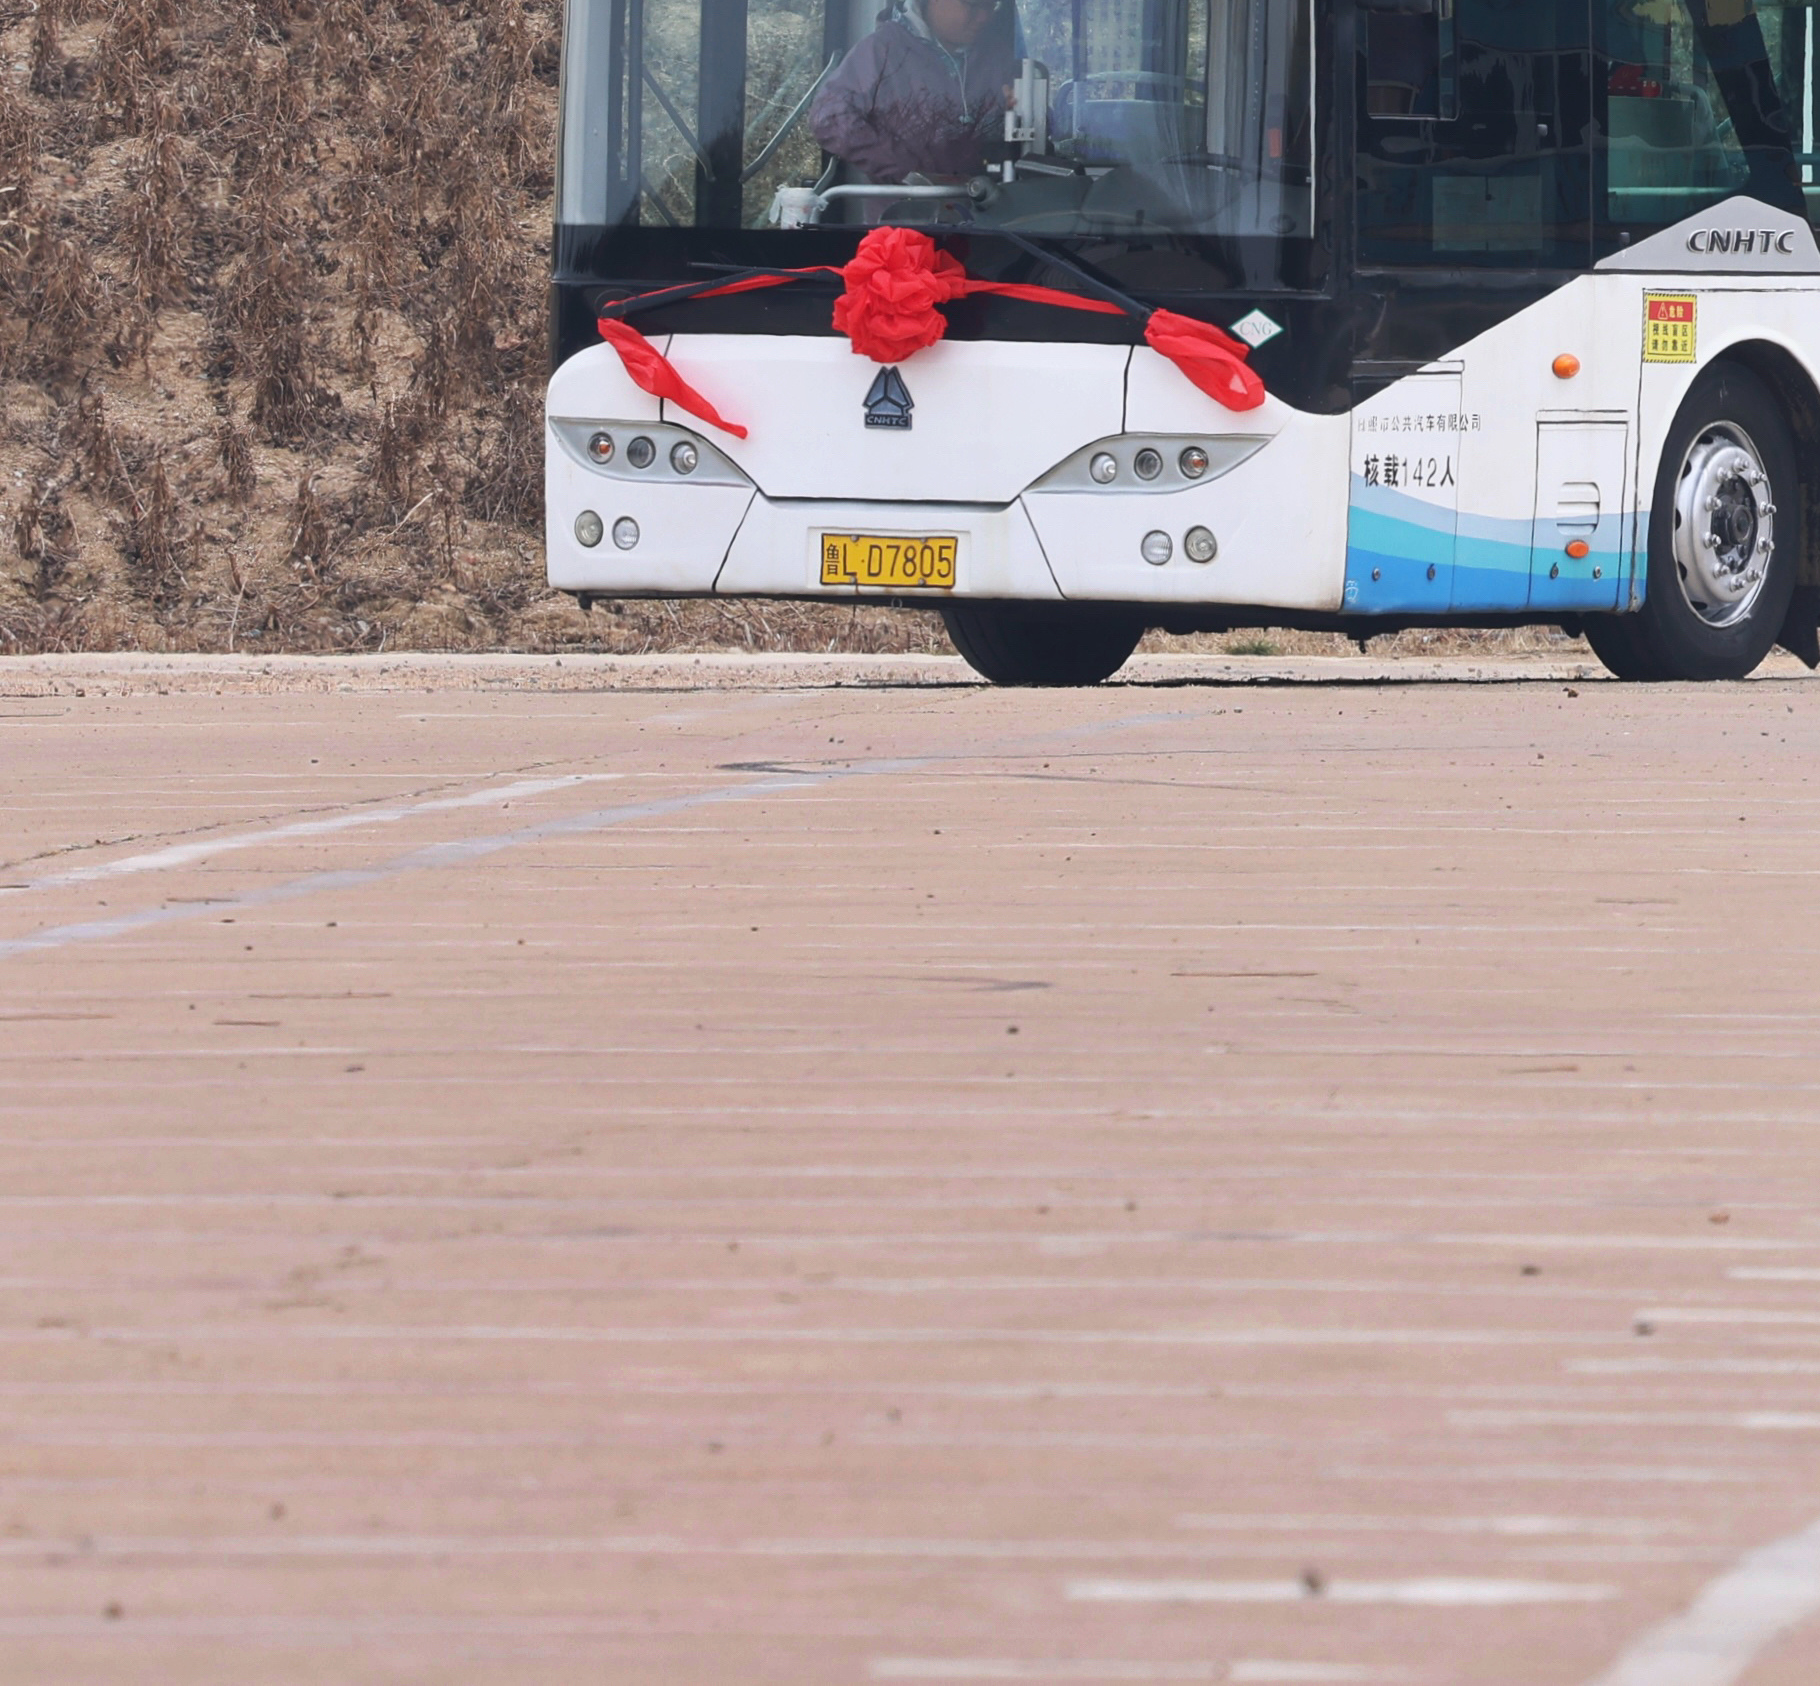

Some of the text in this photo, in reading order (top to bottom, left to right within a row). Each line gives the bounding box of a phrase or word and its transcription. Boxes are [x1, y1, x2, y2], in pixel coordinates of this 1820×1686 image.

[1687, 228, 1795, 254] CNHTC
[1240, 321, 1272, 335] CNG
[866, 415, 907, 425] CNHTC
[1364, 454, 1455, 488] 核载142人
